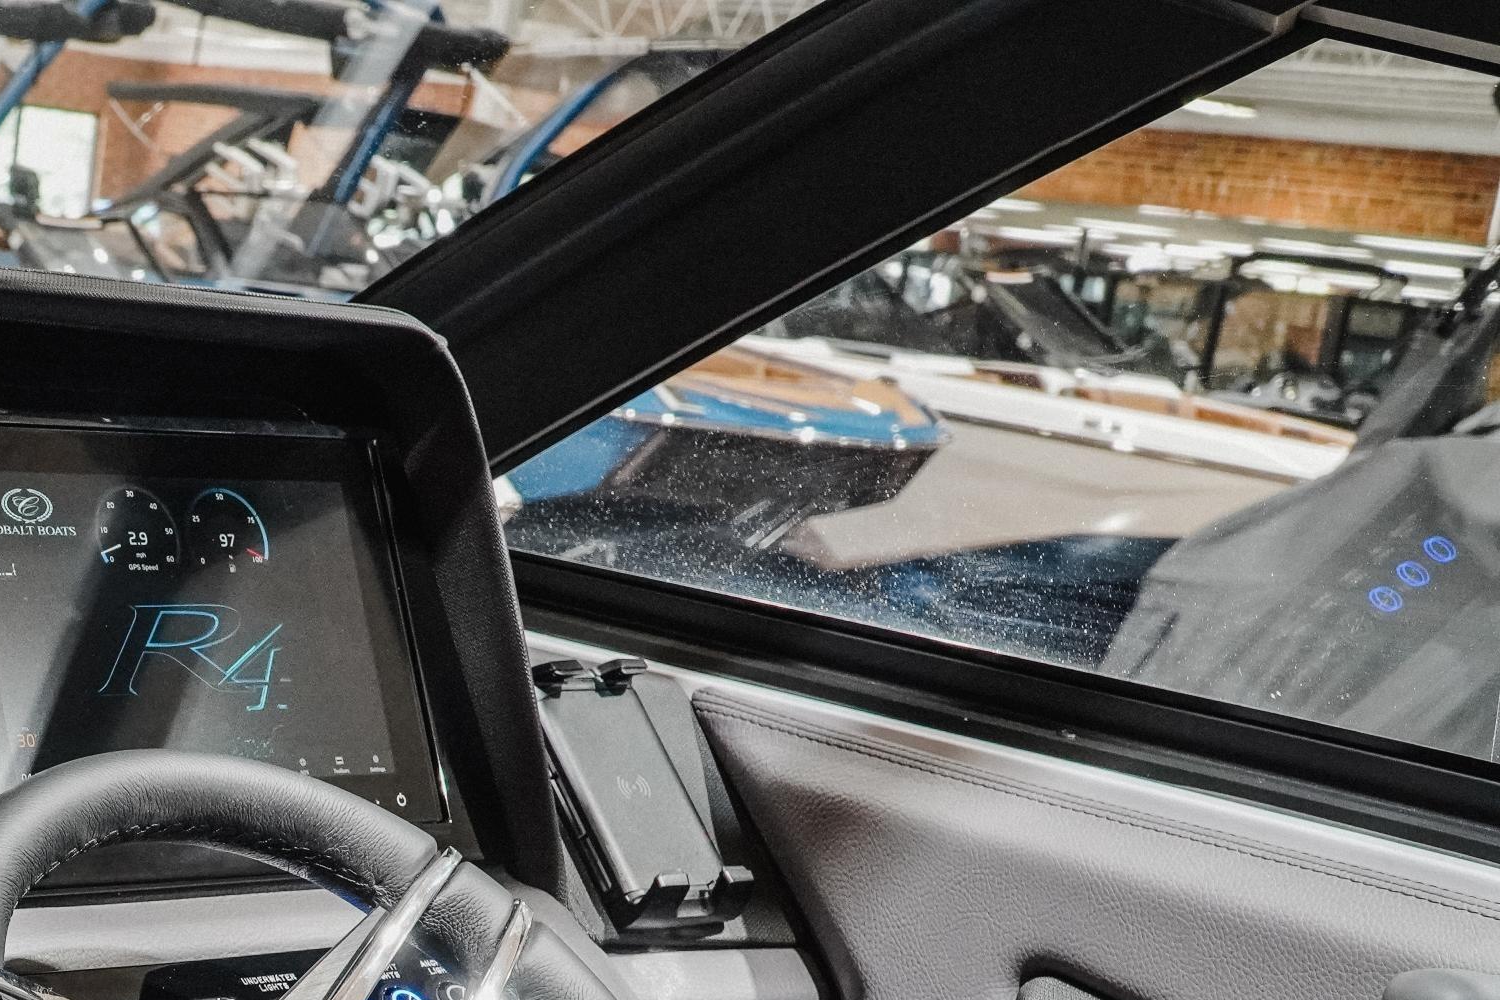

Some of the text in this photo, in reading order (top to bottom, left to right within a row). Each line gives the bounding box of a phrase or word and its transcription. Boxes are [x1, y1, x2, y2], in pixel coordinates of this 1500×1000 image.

[126, 490, 134, 498] 30
[38, 526, 77, 536] BOATS
[128, 532, 148, 546] 2.9
[219, 533, 235, 548] 97
[142, 564, 158, 572] Speed
[241, 973, 298, 986] UNDERWATER
[259, 982, 290, 992] LIGHTS
